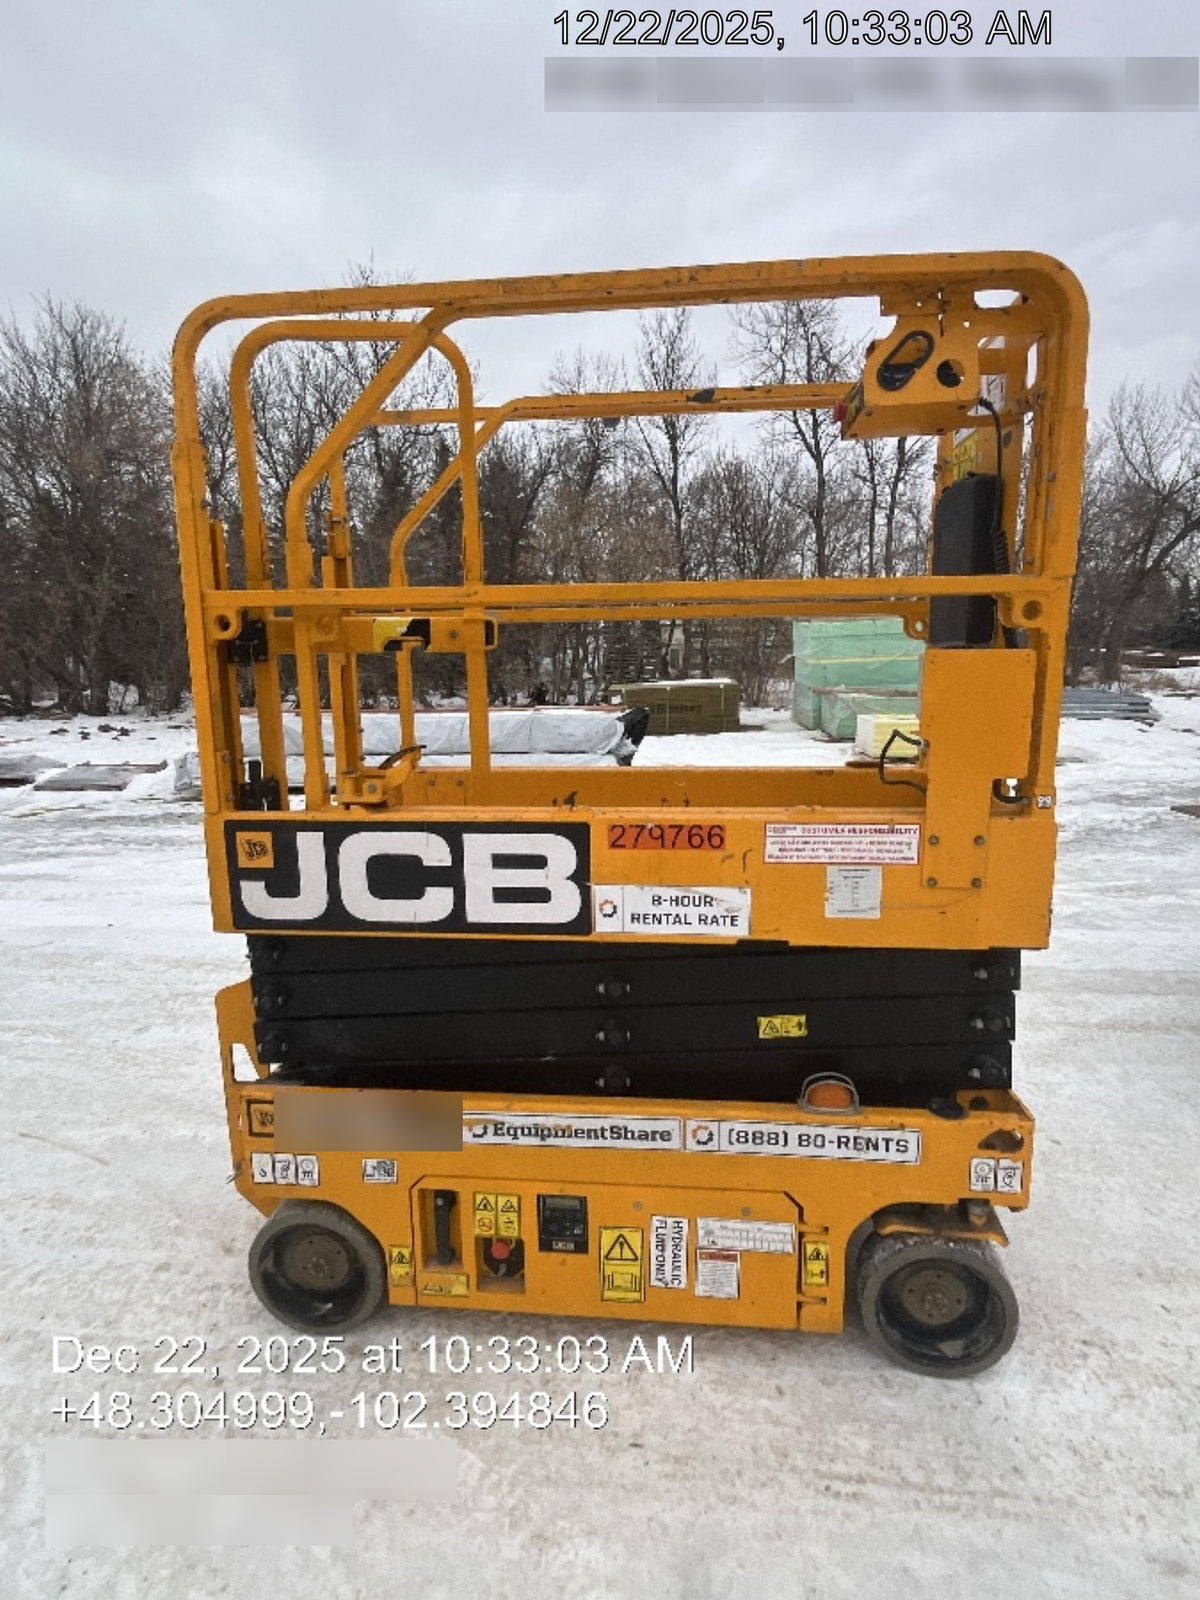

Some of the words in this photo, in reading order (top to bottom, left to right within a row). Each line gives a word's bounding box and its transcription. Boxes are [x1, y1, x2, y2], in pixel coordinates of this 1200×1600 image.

[609, 824, 725, 849] 279766
[240, 831, 582, 924] JCB
[630, 913, 692, 926] RENTAL
[698, 913, 740, 927] RATE
[492, 1121, 673, 1142] EquipmentShare
[728, 1128, 789, 1148] (888)
[655, 1219, 668, 1252] FLUID
[671, 1220, 684, 1287] HYDRAULIC
